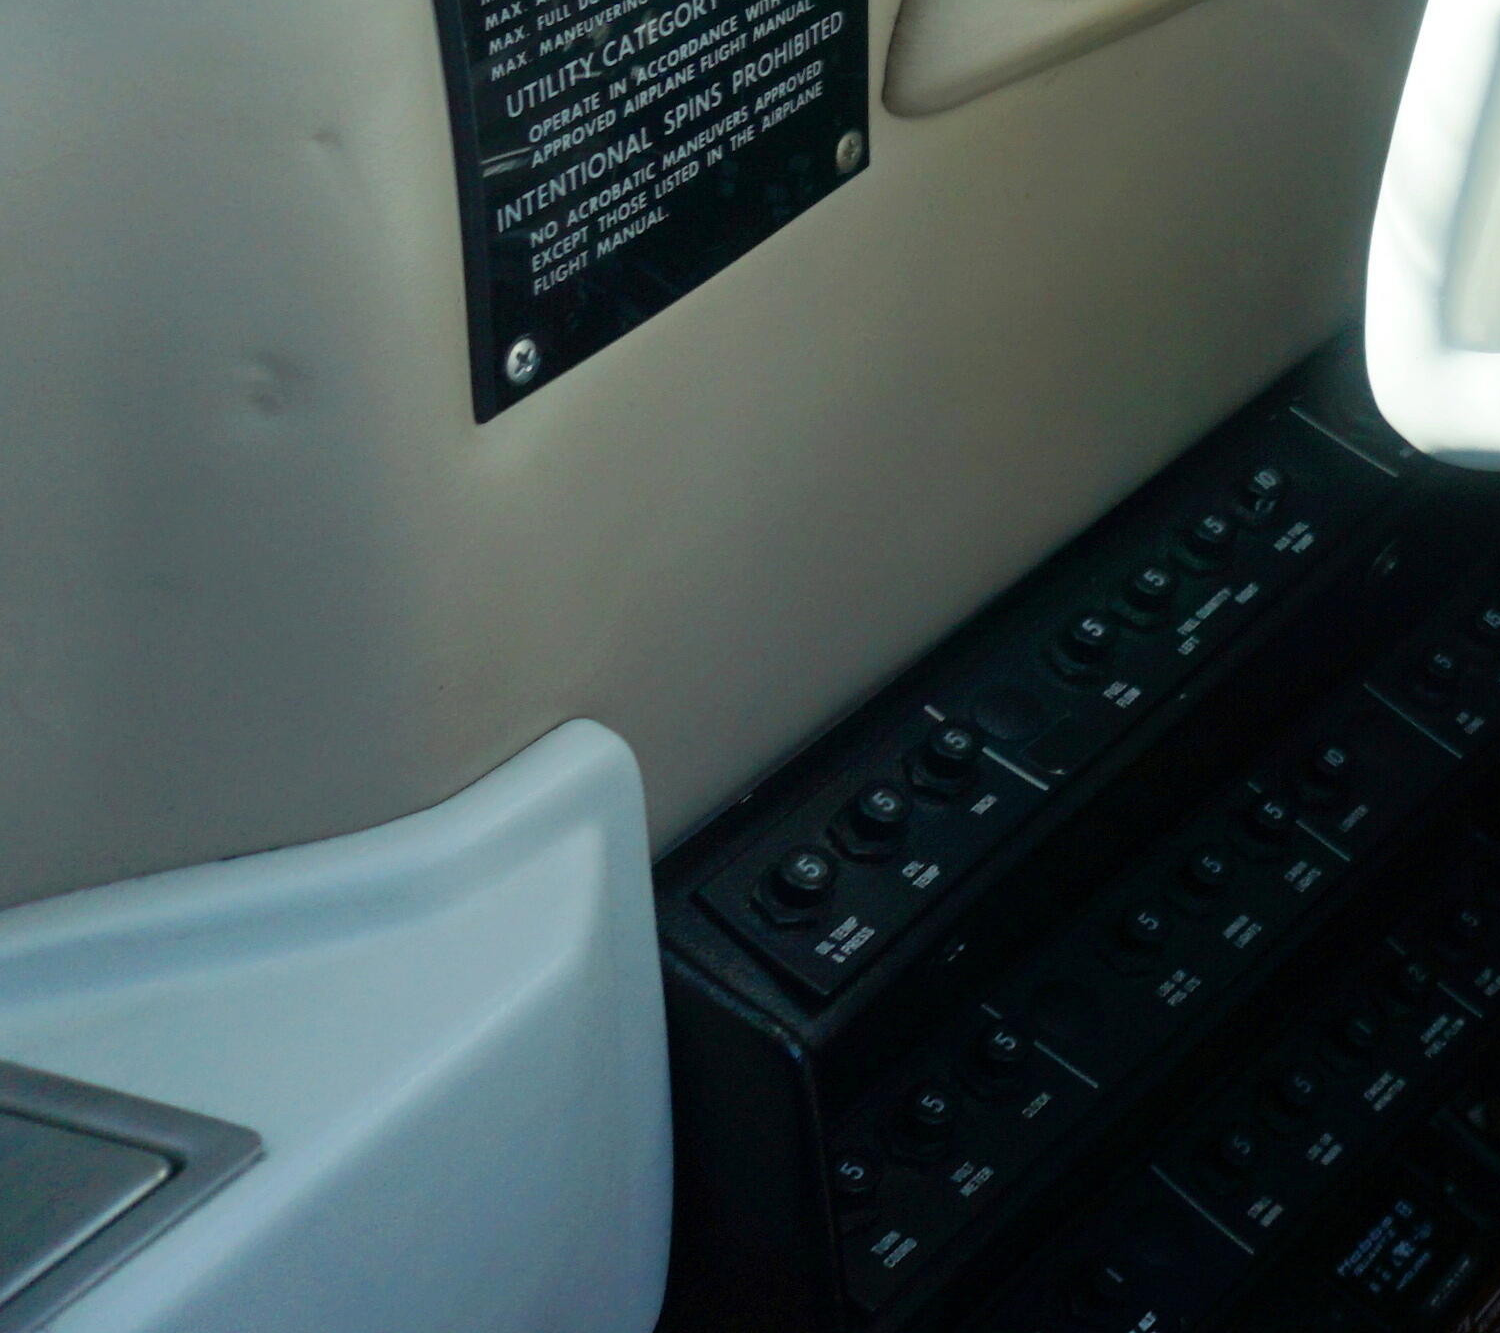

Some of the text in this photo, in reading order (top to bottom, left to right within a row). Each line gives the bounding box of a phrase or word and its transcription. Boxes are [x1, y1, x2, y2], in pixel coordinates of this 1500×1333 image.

[496, 11, 844, 233] INTENTIONAL SPINS PROHIBITED
[506, 52, 595, 119] UTILITY
[530, 60, 823, 248] NO ACROBATIC MANEUVERS APPROVED
